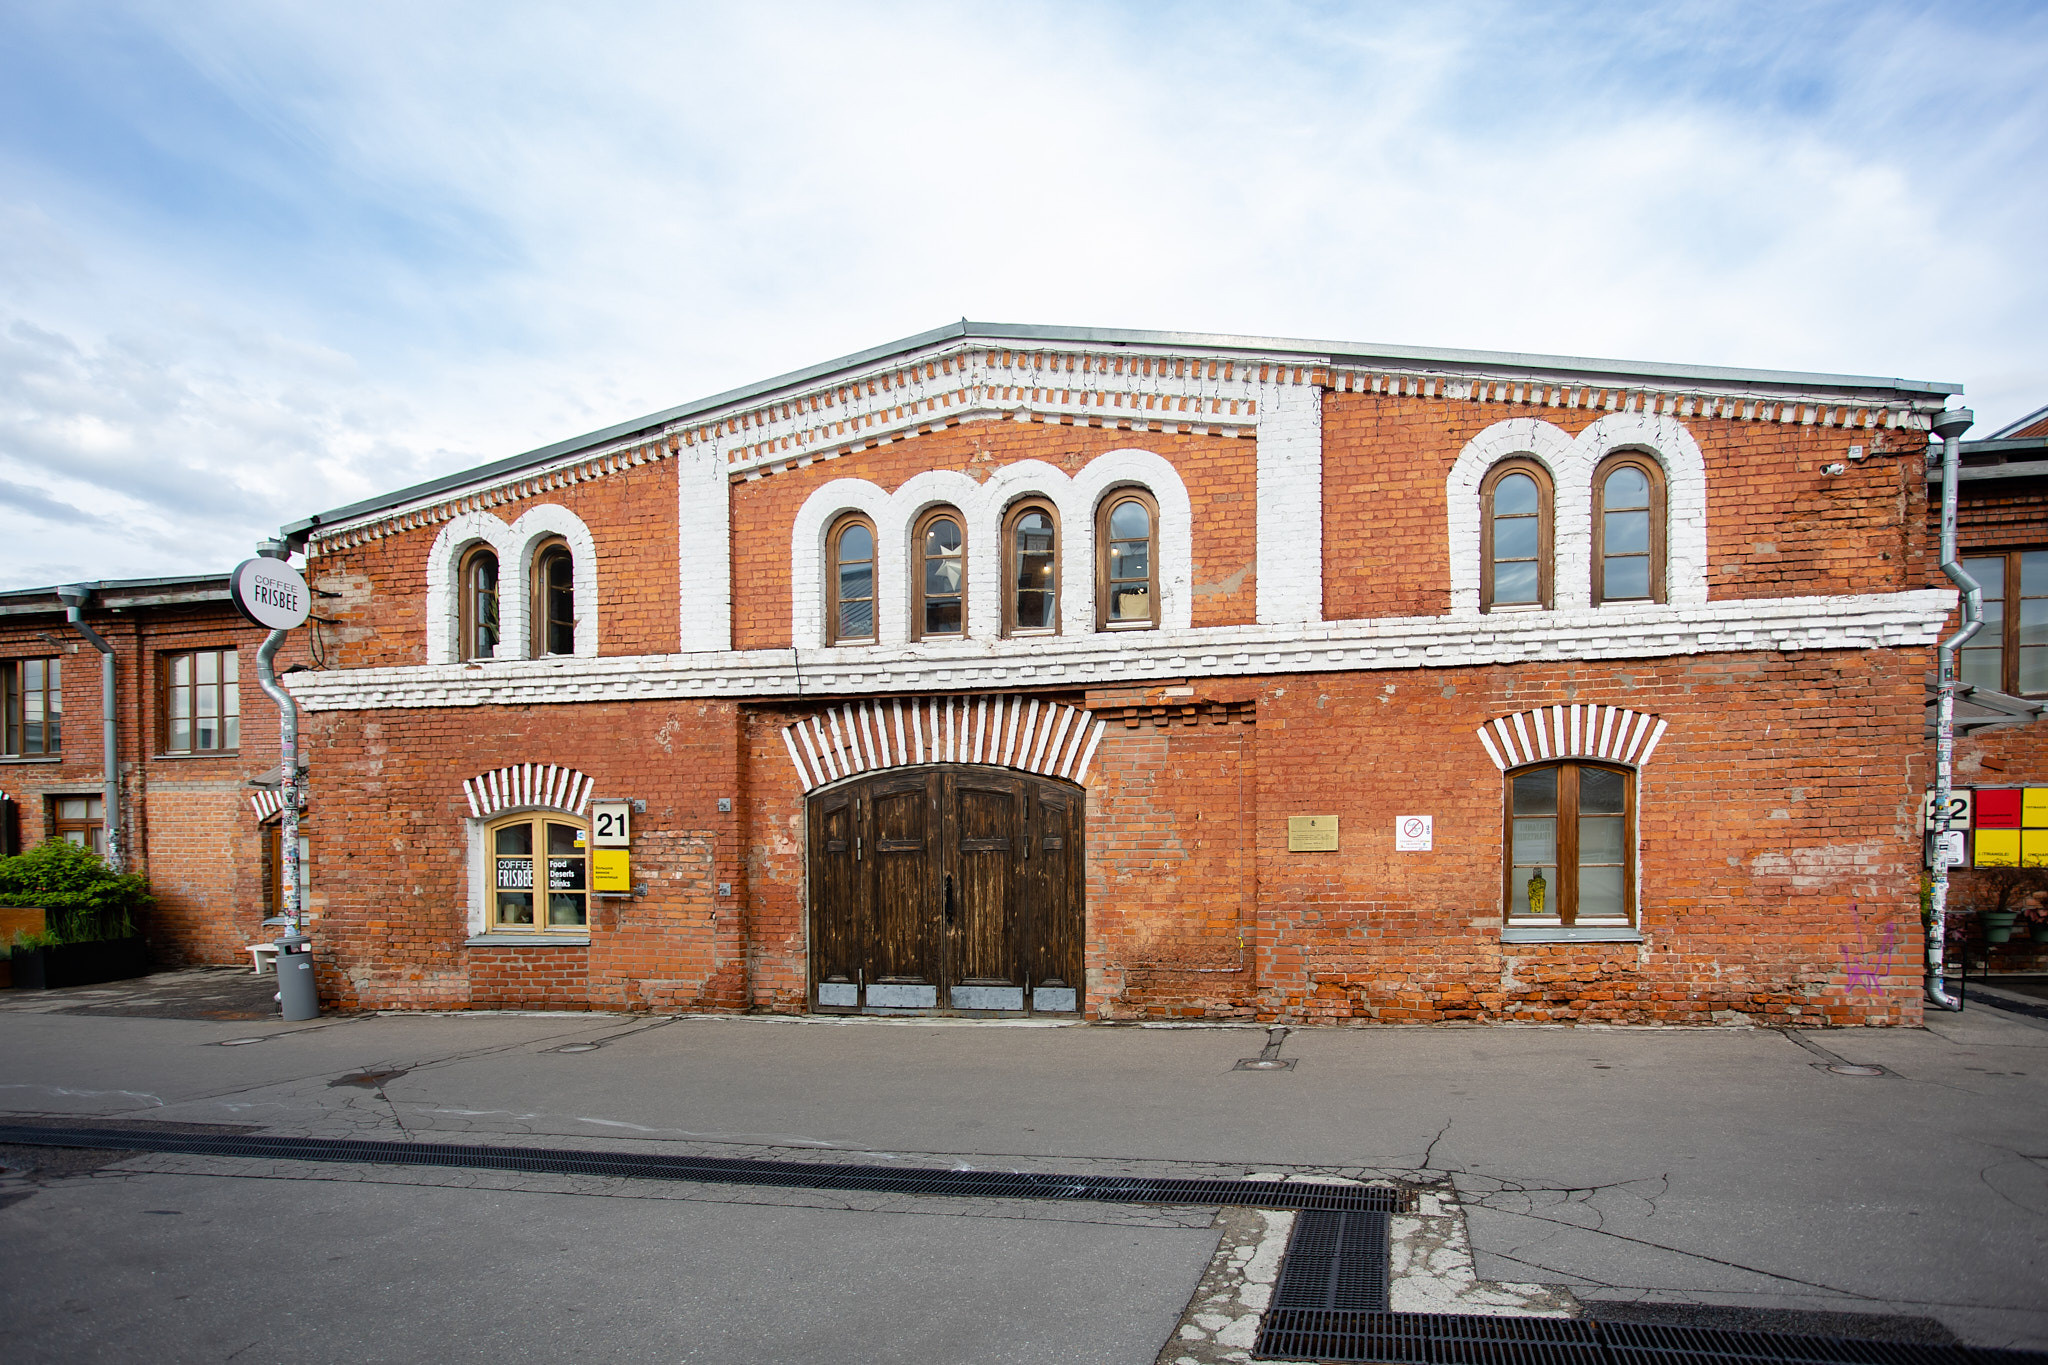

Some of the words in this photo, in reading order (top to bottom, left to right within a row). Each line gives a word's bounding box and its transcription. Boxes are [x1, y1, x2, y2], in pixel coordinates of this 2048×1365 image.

[255, 575, 298, 593] COFFEE
[255, 584, 298, 612] FRISBEE
[597, 813, 625, 837] 21
[498, 860, 533, 869] COFFEE
[549, 860, 567, 868] Food
[498, 869, 533, 887] FRISBEE
[549, 870, 575, 878] Deserts
[549, 879, 571, 888] Drinks
